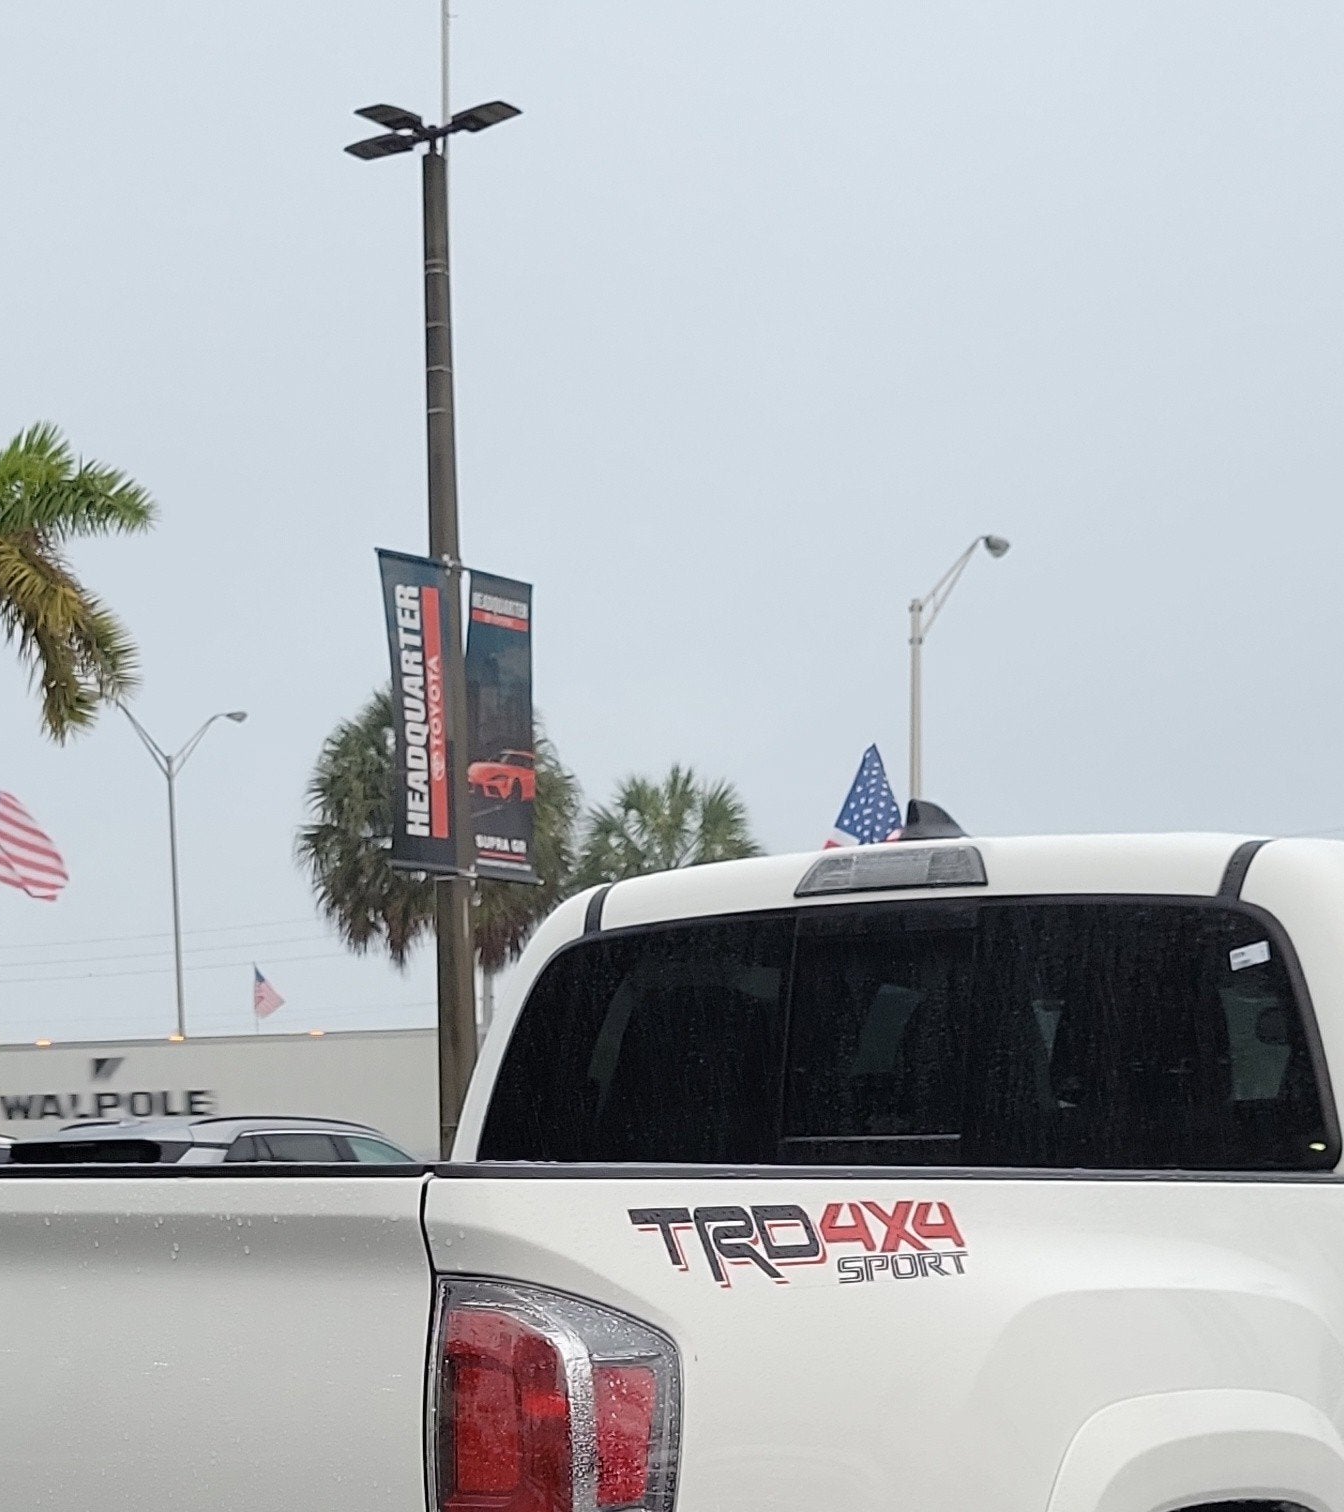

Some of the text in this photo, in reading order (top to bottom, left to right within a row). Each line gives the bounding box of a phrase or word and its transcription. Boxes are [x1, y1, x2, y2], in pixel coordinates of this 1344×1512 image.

[395, 584, 430, 838] HEADQUARTER
[427, 654, 444, 746] TOYOTA
[0, 1090, 213, 1120] WALPOLE
[627, 1204, 827, 1288] TRD
[837, 1251, 968, 1285] SPORT
